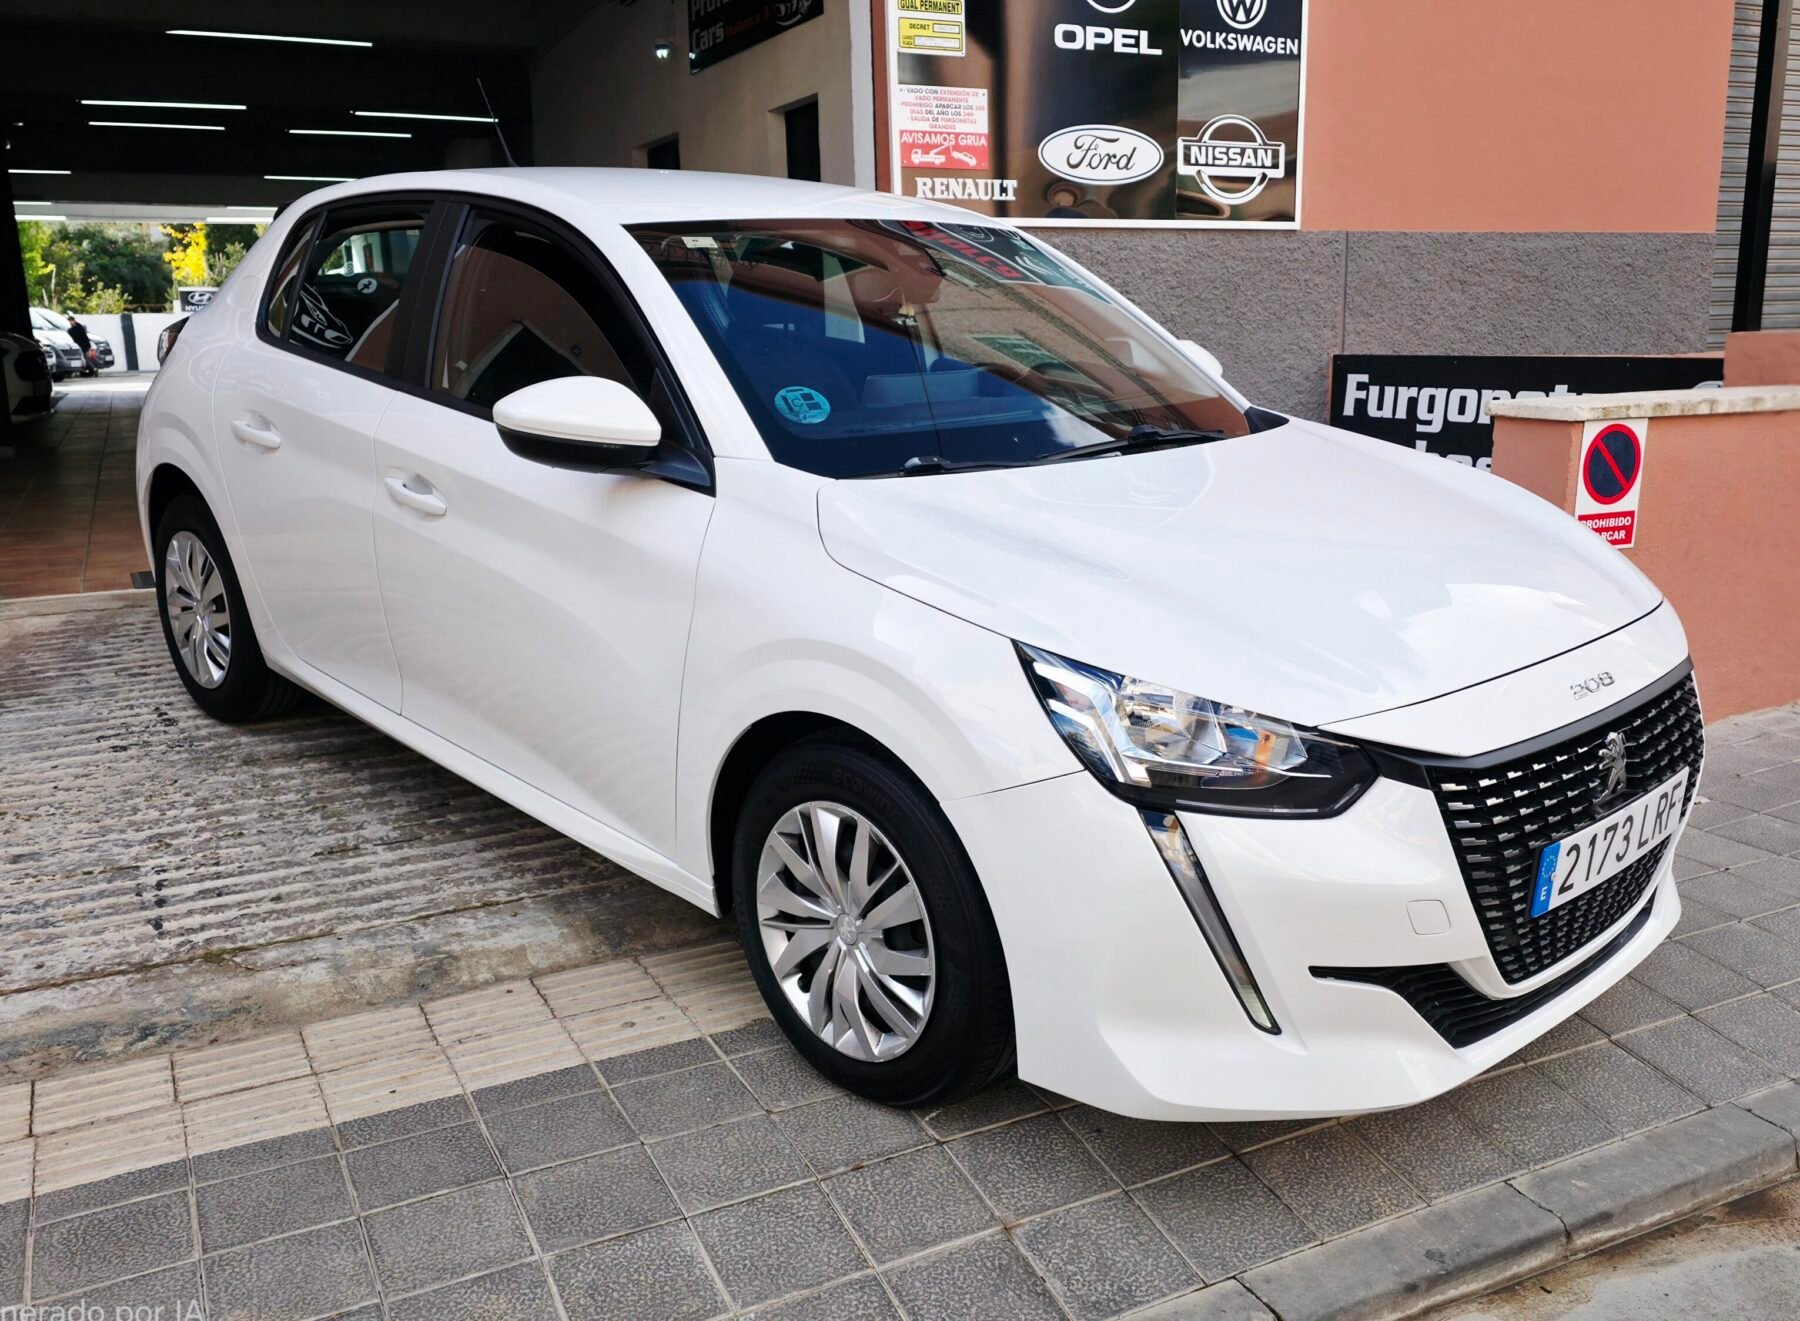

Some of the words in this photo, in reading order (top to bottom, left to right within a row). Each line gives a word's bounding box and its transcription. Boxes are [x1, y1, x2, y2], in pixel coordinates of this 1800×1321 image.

[920, 0, 960, 12] PERMANENT
[692, 21, 725, 51] Cars
[1054, 23, 1163, 56] OPEL
[1180, 28, 1299, 55] VOLKSWAGEN
[901, 132, 956, 145] AVISAMOS
[958, 134, 987, 147] GRUA
[1066, 134, 1138, 171] Ford
[1190, 145, 1272, 168] NISSAN
[914, 177, 1018, 201] RENAULT
[1600, 530, 1626, 541] RCAR
[1569, 671, 1616, 702] 208
[1557, 815, 1634, 896] 2173
[1636, 780, 1683, 852] LRF
